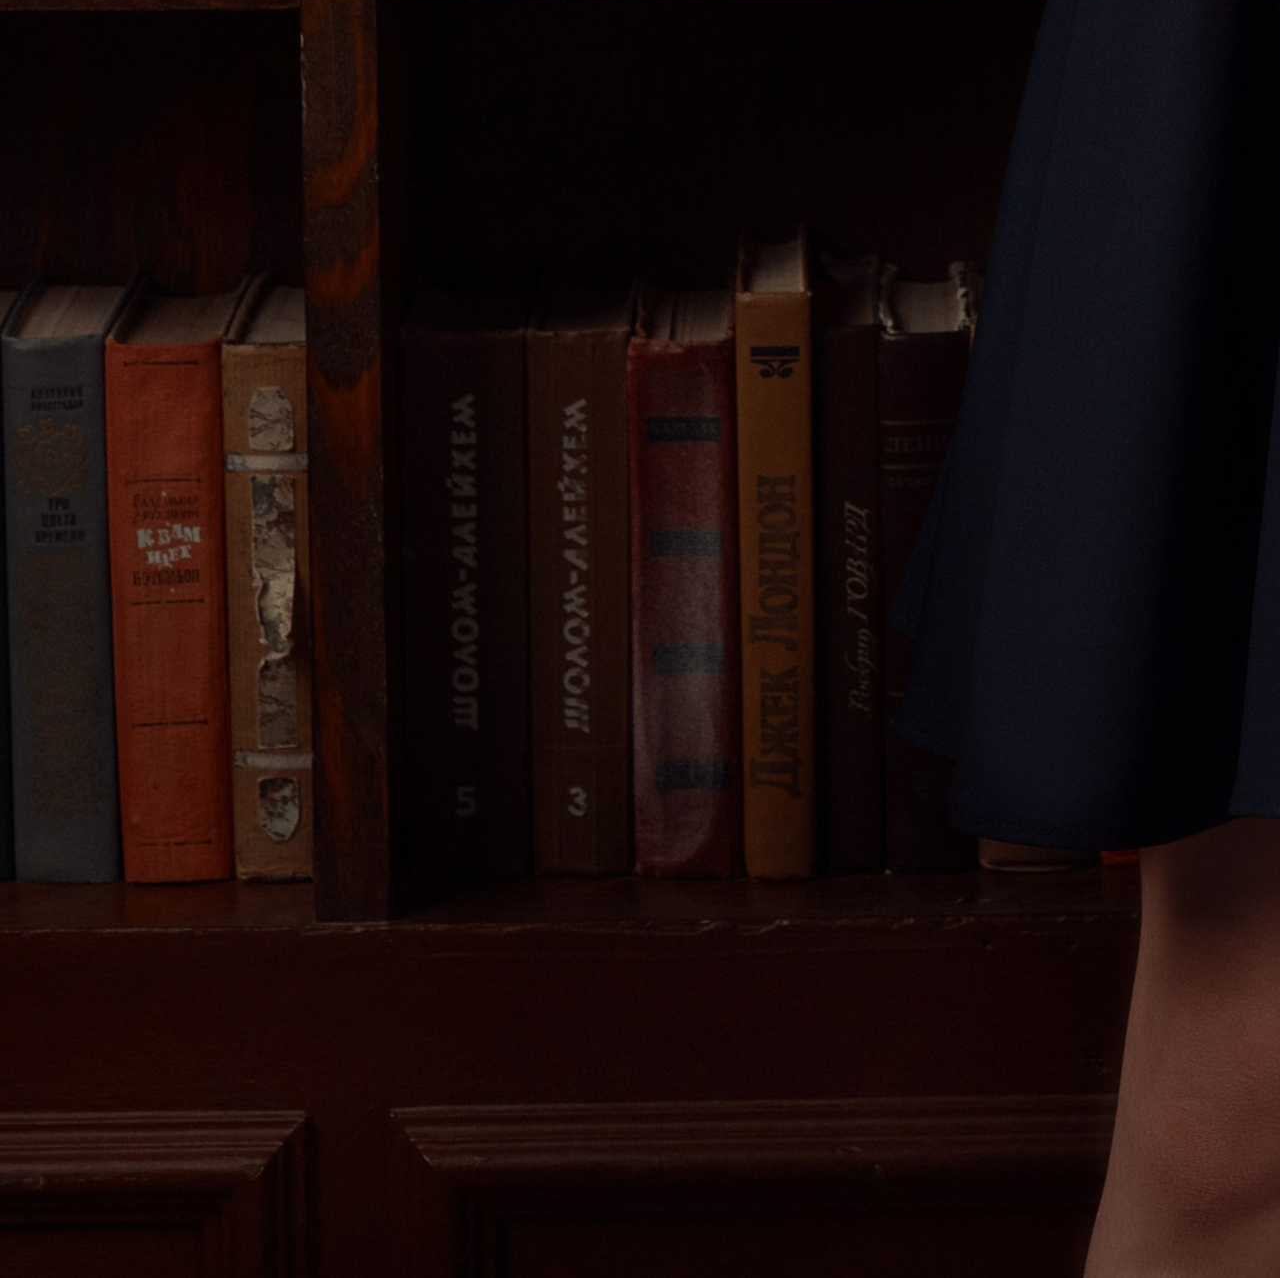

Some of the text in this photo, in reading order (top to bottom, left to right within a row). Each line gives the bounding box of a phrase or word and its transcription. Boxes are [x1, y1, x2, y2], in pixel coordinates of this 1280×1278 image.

[157, 524, 202, 546] ВАМ
[446, 392, 481, 733] ШОЛОМ-АЛЕЙХЕМ
[556, 396, 593, 734] ШОЛОМ-АЛЕЙХЕМ
[455, 785, 478, 817] 5
[566, 785, 589, 817] 3
